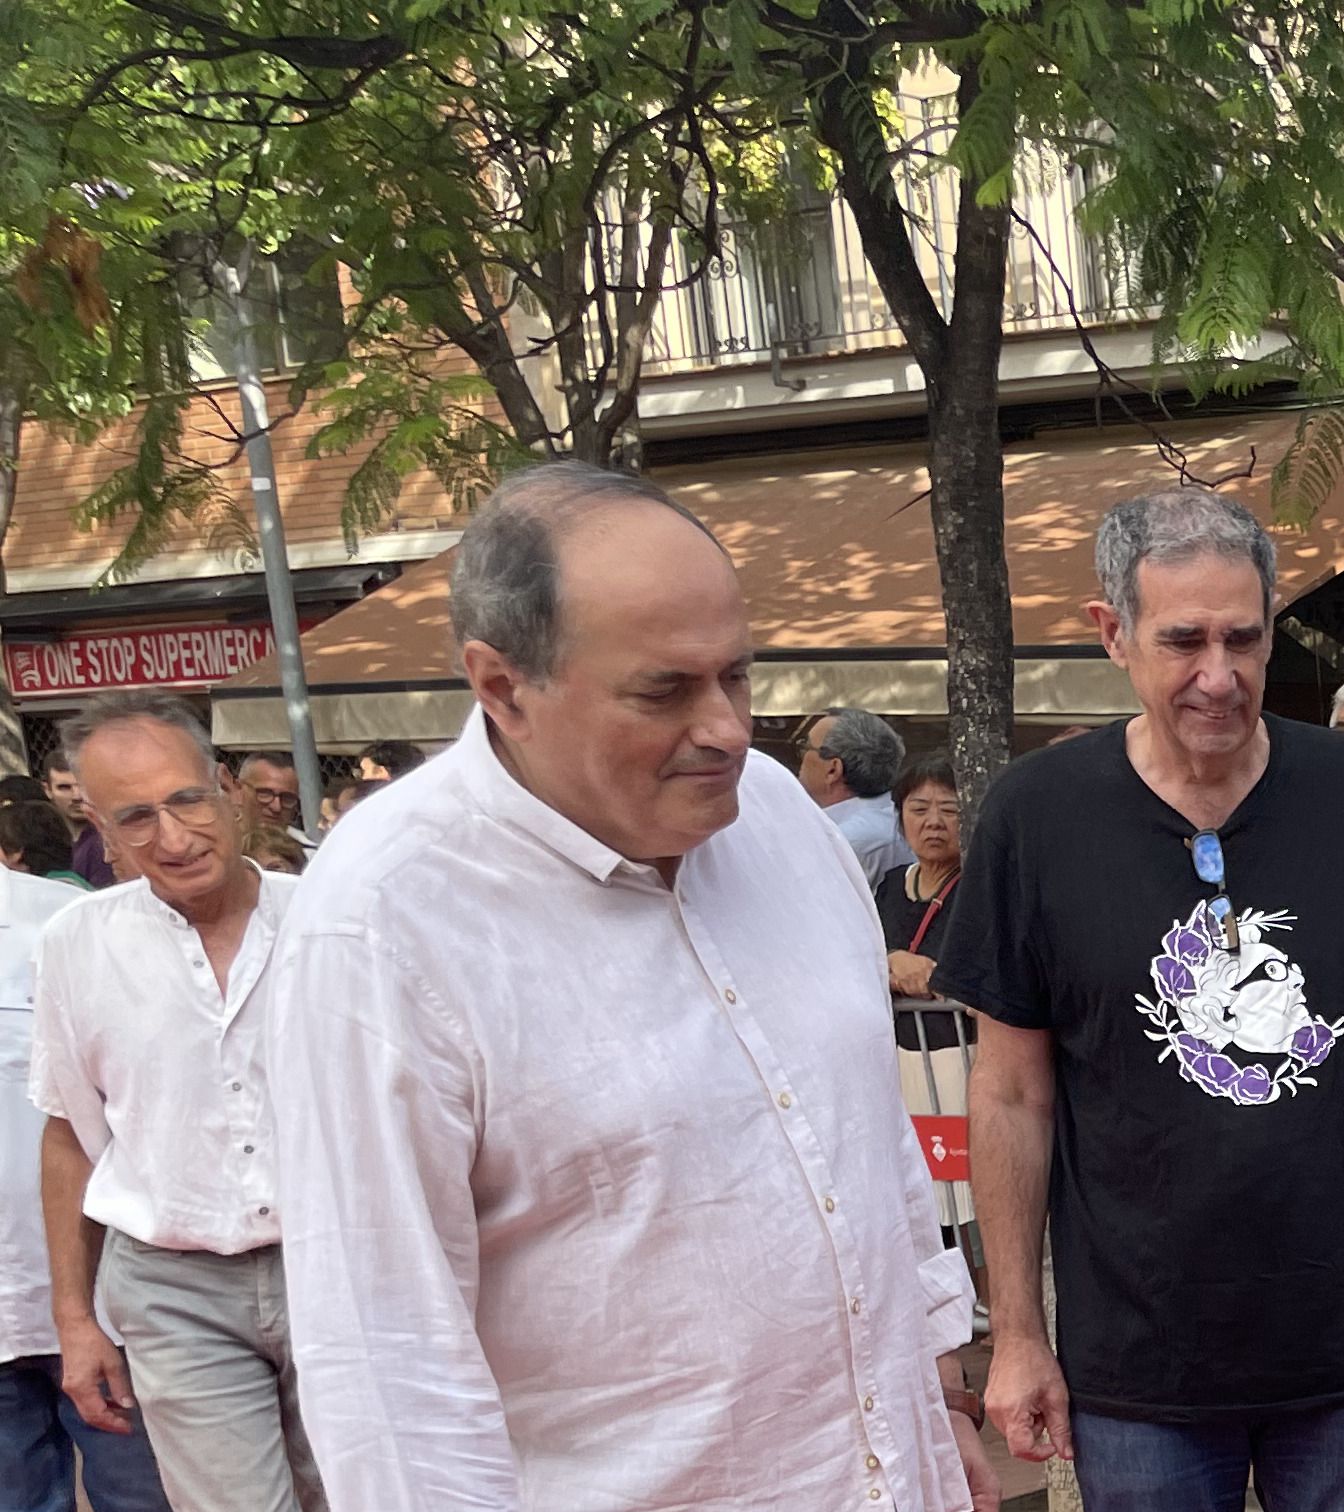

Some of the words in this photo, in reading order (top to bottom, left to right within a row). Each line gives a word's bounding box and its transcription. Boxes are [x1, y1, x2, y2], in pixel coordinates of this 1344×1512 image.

[43, 641, 86, 687] ONE
[86, 636, 137, 684] STOP
[139, 628, 278, 682] SUPERMERCA
